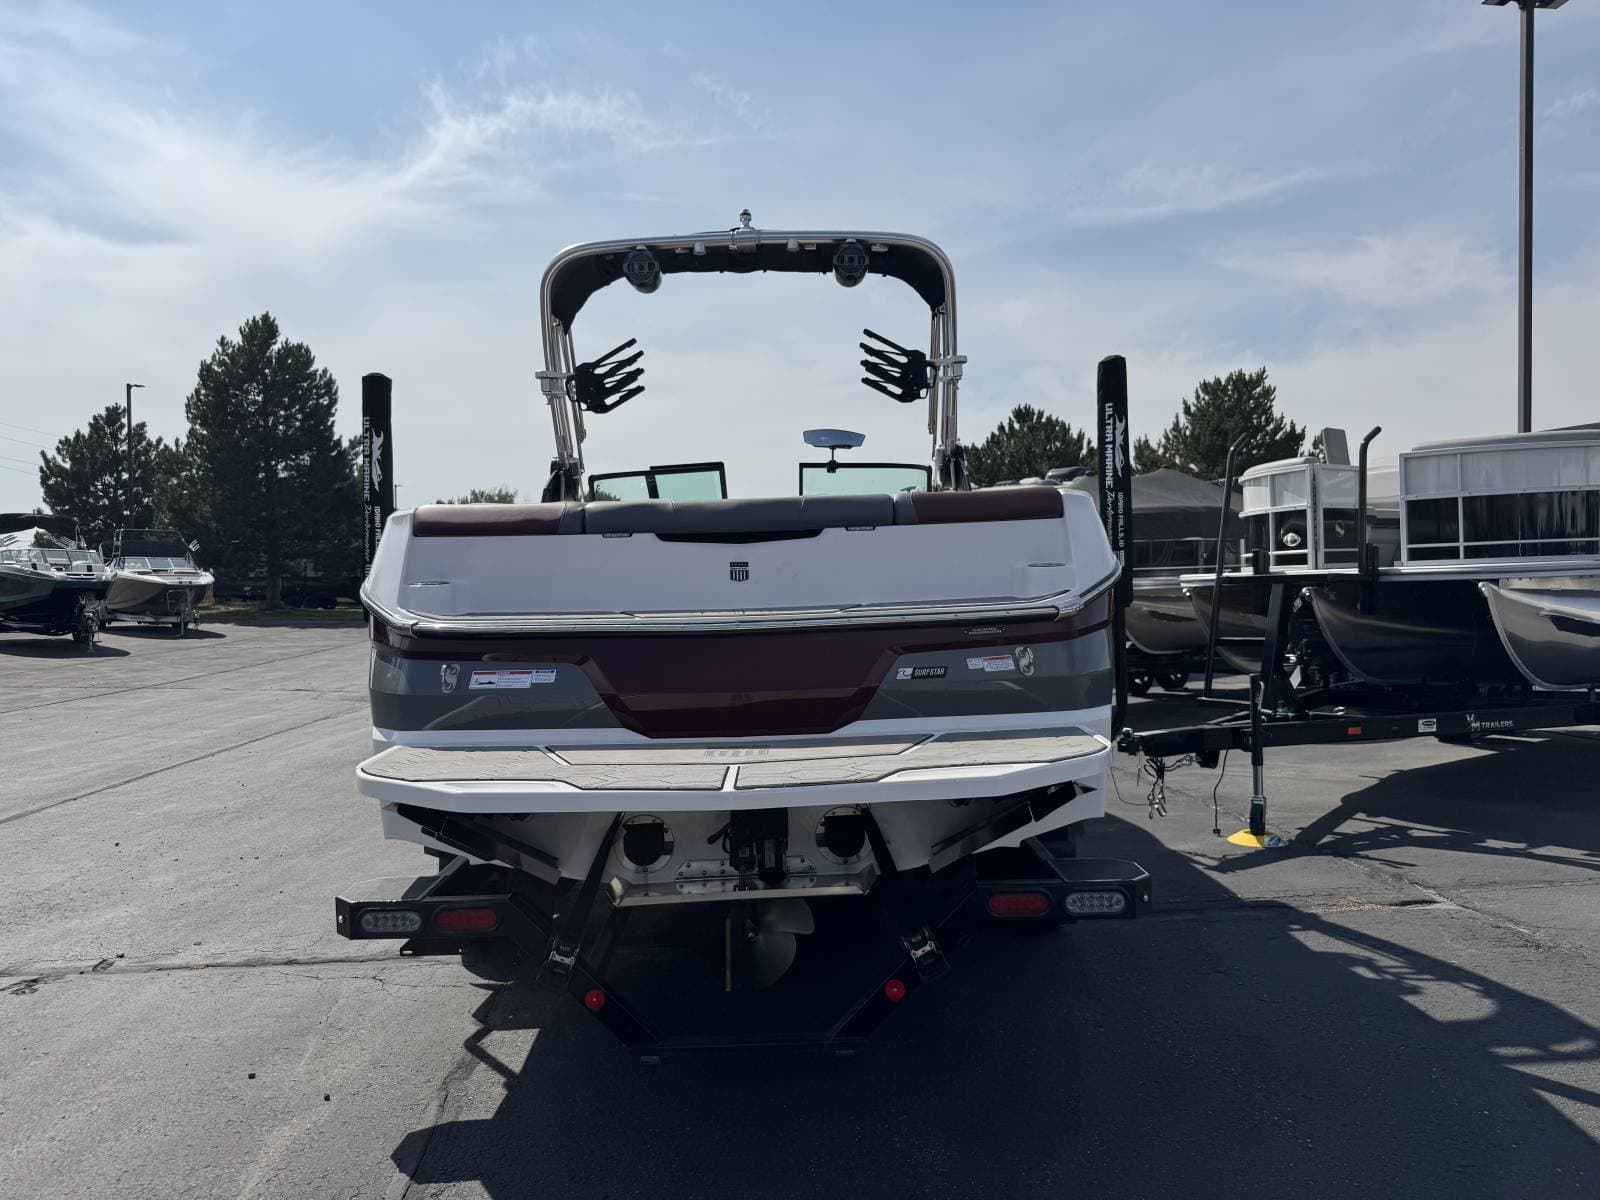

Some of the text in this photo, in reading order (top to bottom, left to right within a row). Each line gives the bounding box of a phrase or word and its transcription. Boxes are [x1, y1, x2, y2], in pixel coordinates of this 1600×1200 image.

[363, 416, 371, 454] ULTRA
[1105, 403, 1113, 441] ULTRA
[363, 457, 371, 502] MARINE
[1105, 444, 1113, 488] MARINE
[914, 667, 945, 677] SURFSTAR
[1481, 720, 1514, 729] TRAILERS
